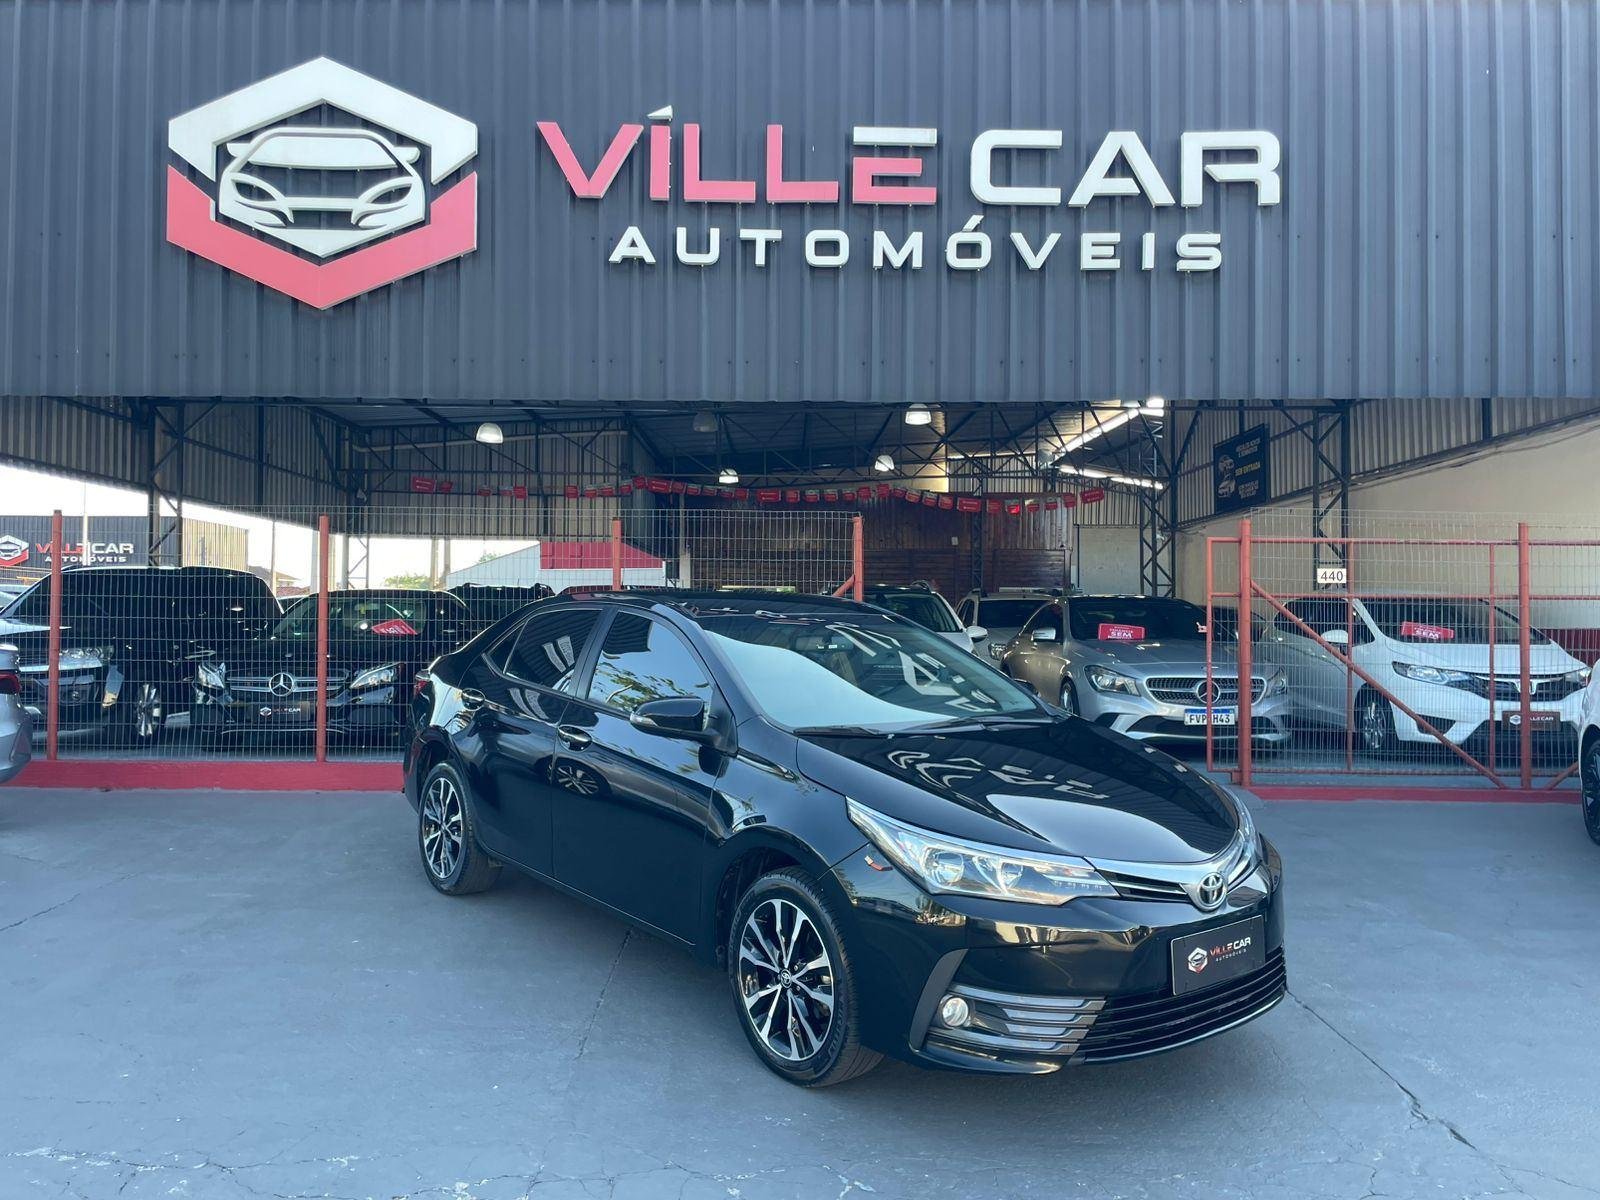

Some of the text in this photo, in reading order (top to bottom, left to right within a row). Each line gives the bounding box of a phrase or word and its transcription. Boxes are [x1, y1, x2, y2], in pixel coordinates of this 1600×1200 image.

[970, 129, 1281, 207] CAR
[609, 214, 1222, 272] AUTOMÓVEIS
[92, 542, 134, 554] CAR
[1320, 570, 1343, 582] 440
[1189, 714, 1230, 724] FVPH43
[1233, 936, 1251, 950] CAR
